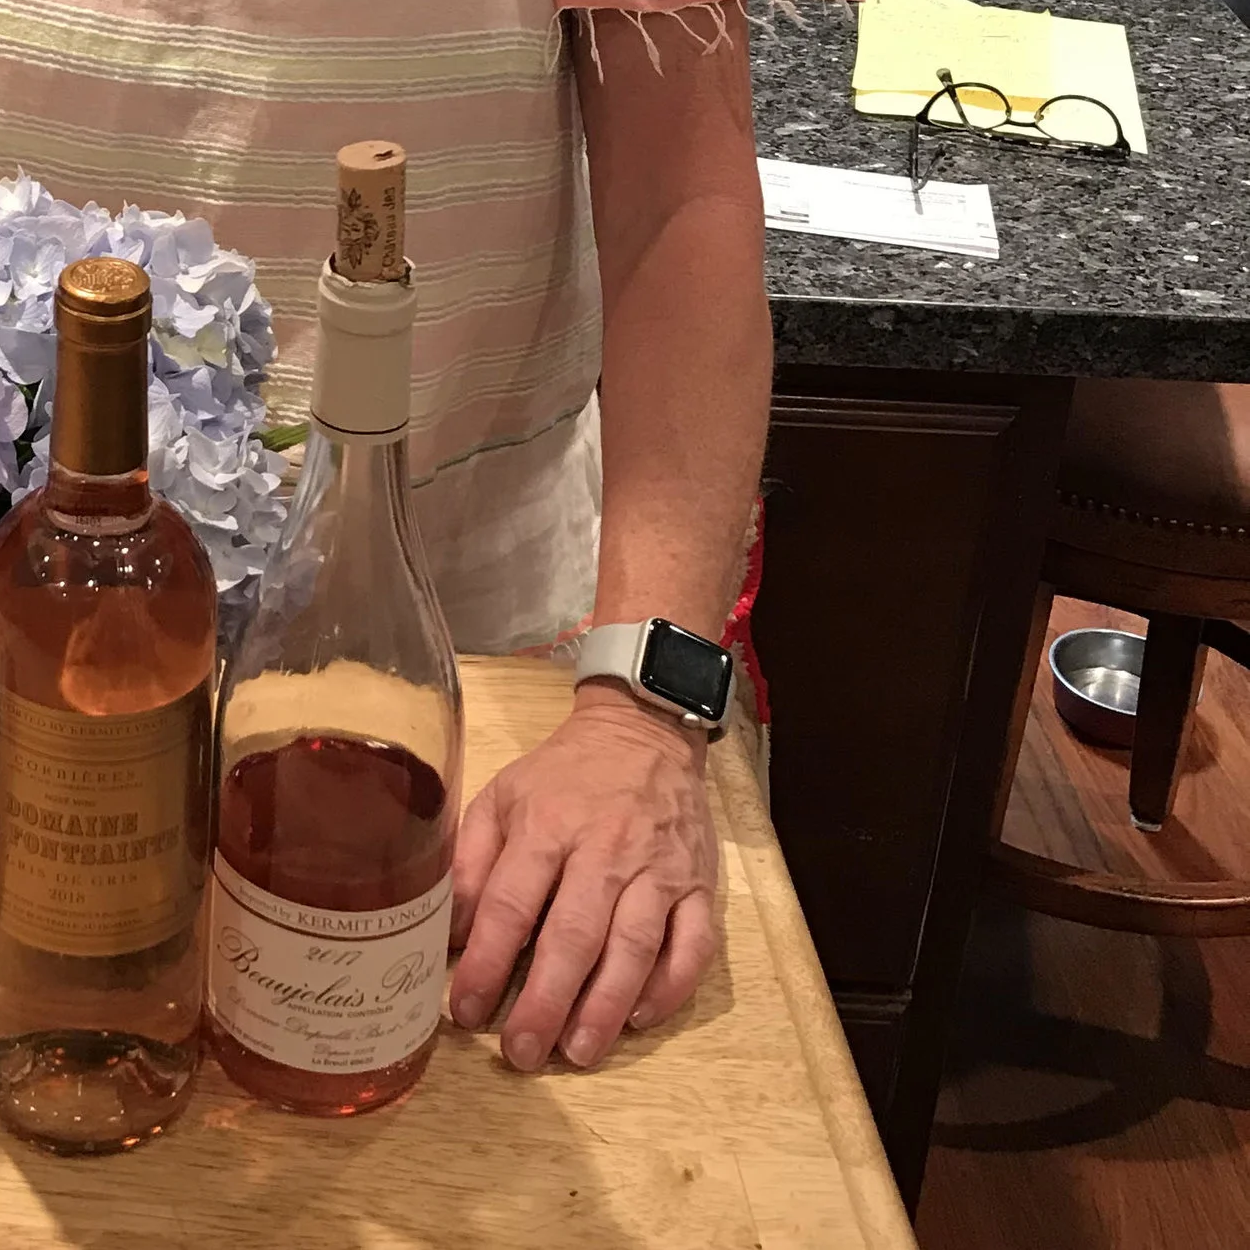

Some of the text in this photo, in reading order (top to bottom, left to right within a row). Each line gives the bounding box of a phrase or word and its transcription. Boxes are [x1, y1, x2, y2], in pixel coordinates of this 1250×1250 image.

[13, 752, 137, 784] CORBIÈRES
[6, 793, 139, 838] DOMAINE
[55, 873, 82, 887] DE
[278, 905, 291, 921] by
[297, 911, 372, 932] KERMIT
[377, 898, 433, 925] LYNCH
[216, 925, 366, 1008] Beaujolais
[303, 945, 364, 966] 2017
[286, 1002, 344, 1019] APPELLATION
